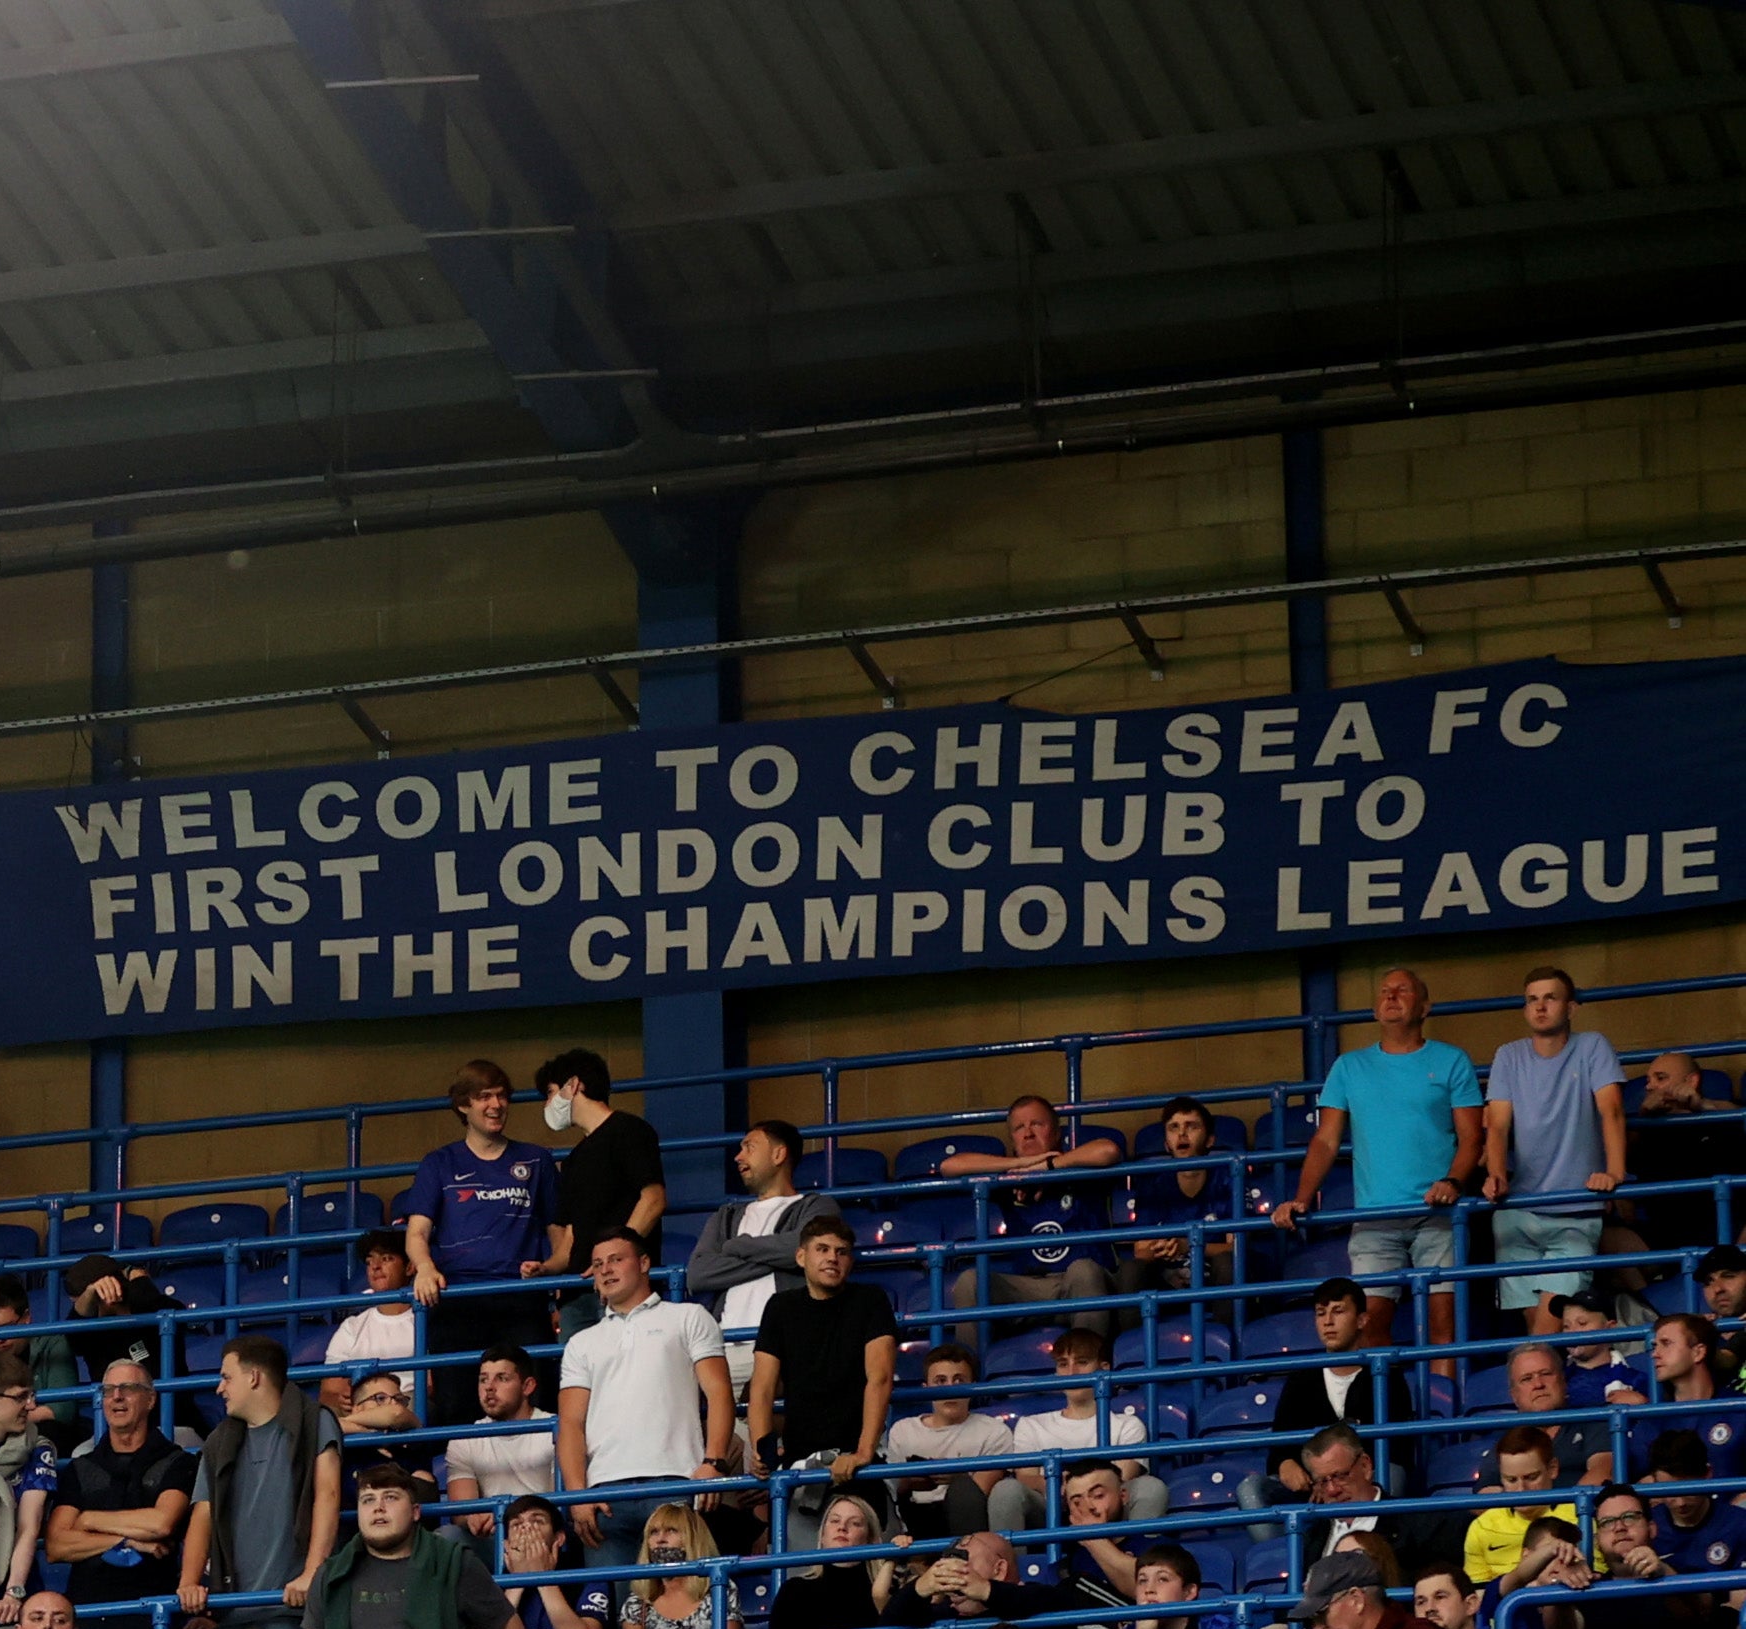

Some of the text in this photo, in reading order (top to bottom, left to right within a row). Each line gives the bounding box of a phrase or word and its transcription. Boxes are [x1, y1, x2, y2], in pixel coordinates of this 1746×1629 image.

[55, 683, 1568, 864] WELCOME TO CHELSEA FC
[90, 776, 1425, 939] FIRST LONDON CLUB TO
[95, 827, 1719, 1015] WIN THE CHAMPIONS LEAGUE
